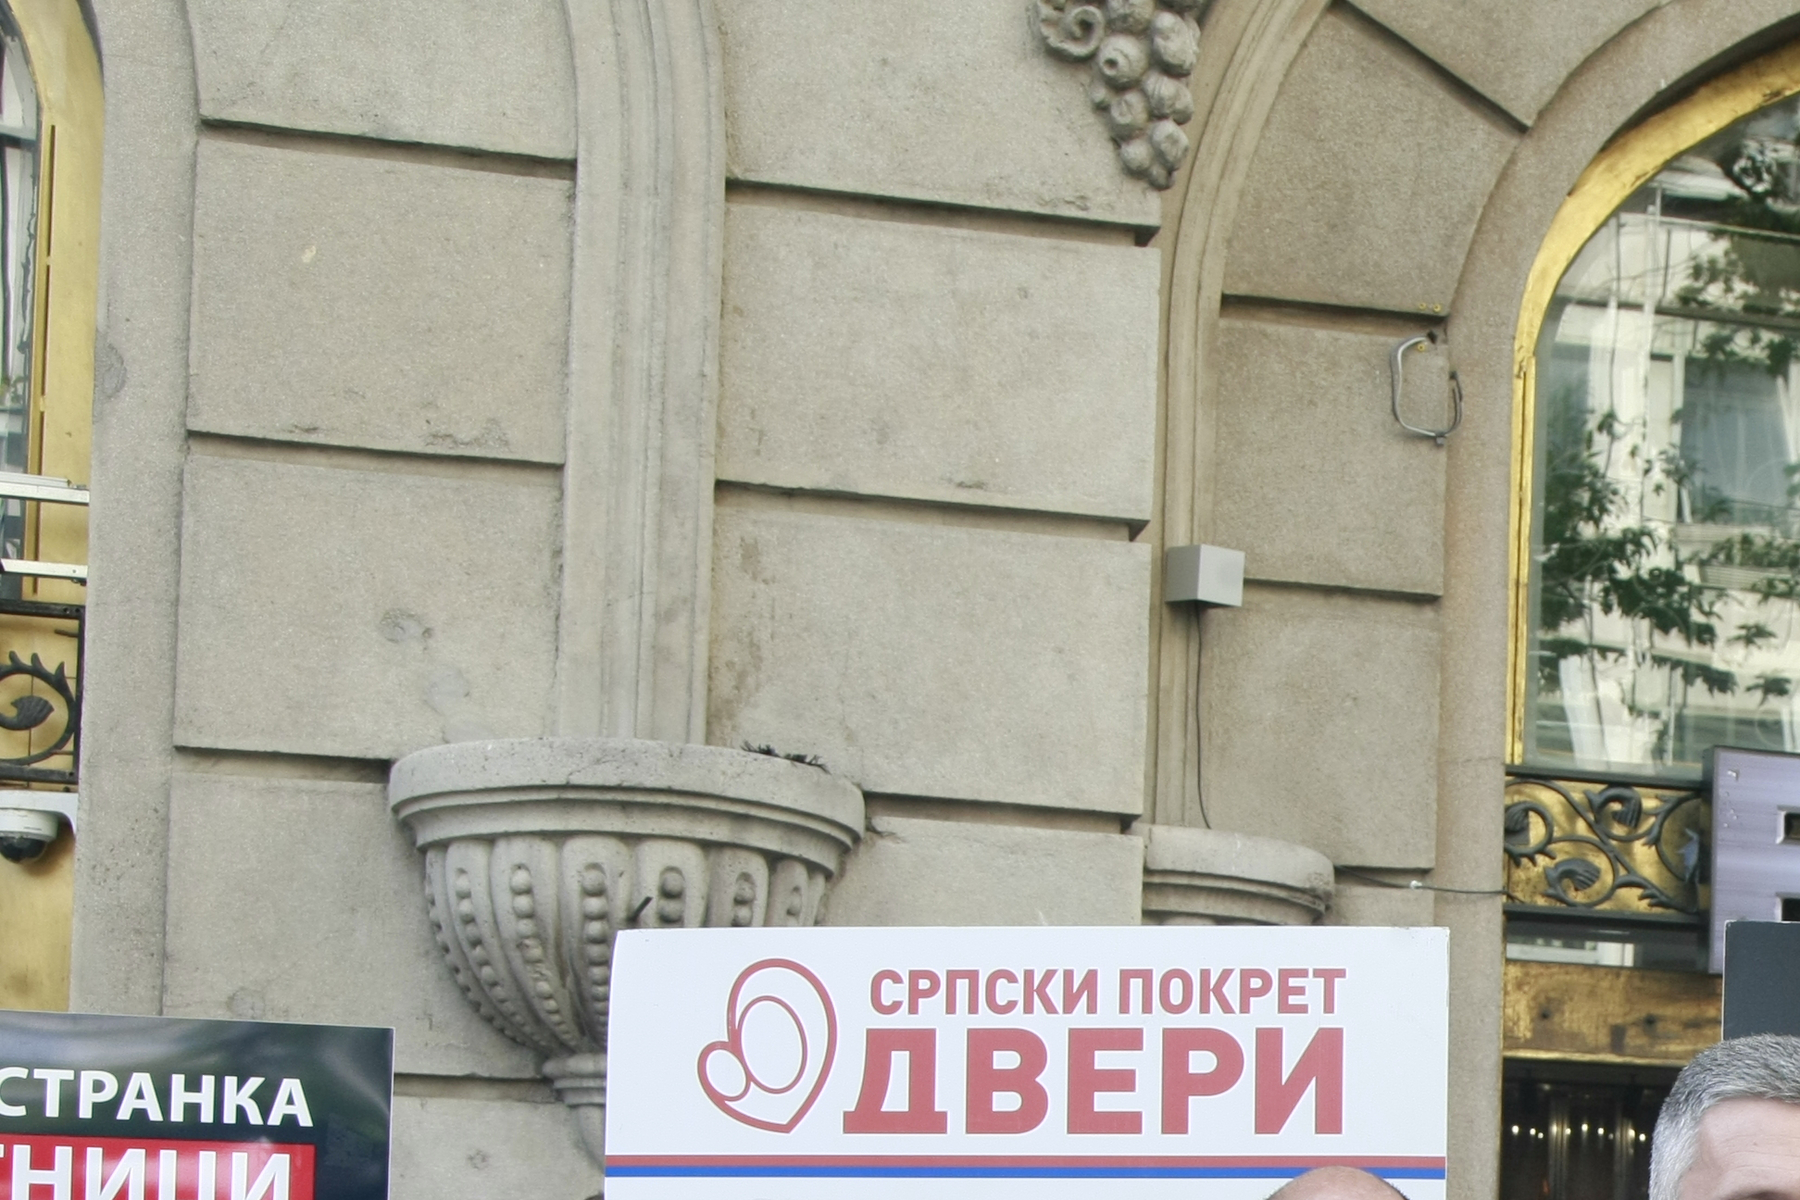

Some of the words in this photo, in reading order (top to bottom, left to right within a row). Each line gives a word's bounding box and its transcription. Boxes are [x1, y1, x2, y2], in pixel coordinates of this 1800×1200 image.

[872, 969, 1098, 1015] СРПСКИ
[1120, 969, 1347, 1014] ПОКРЕТ
[0, 1066, 313, 1127] СТРАНКА
[843, 1027, 1345, 1135] ДВЕРИ
